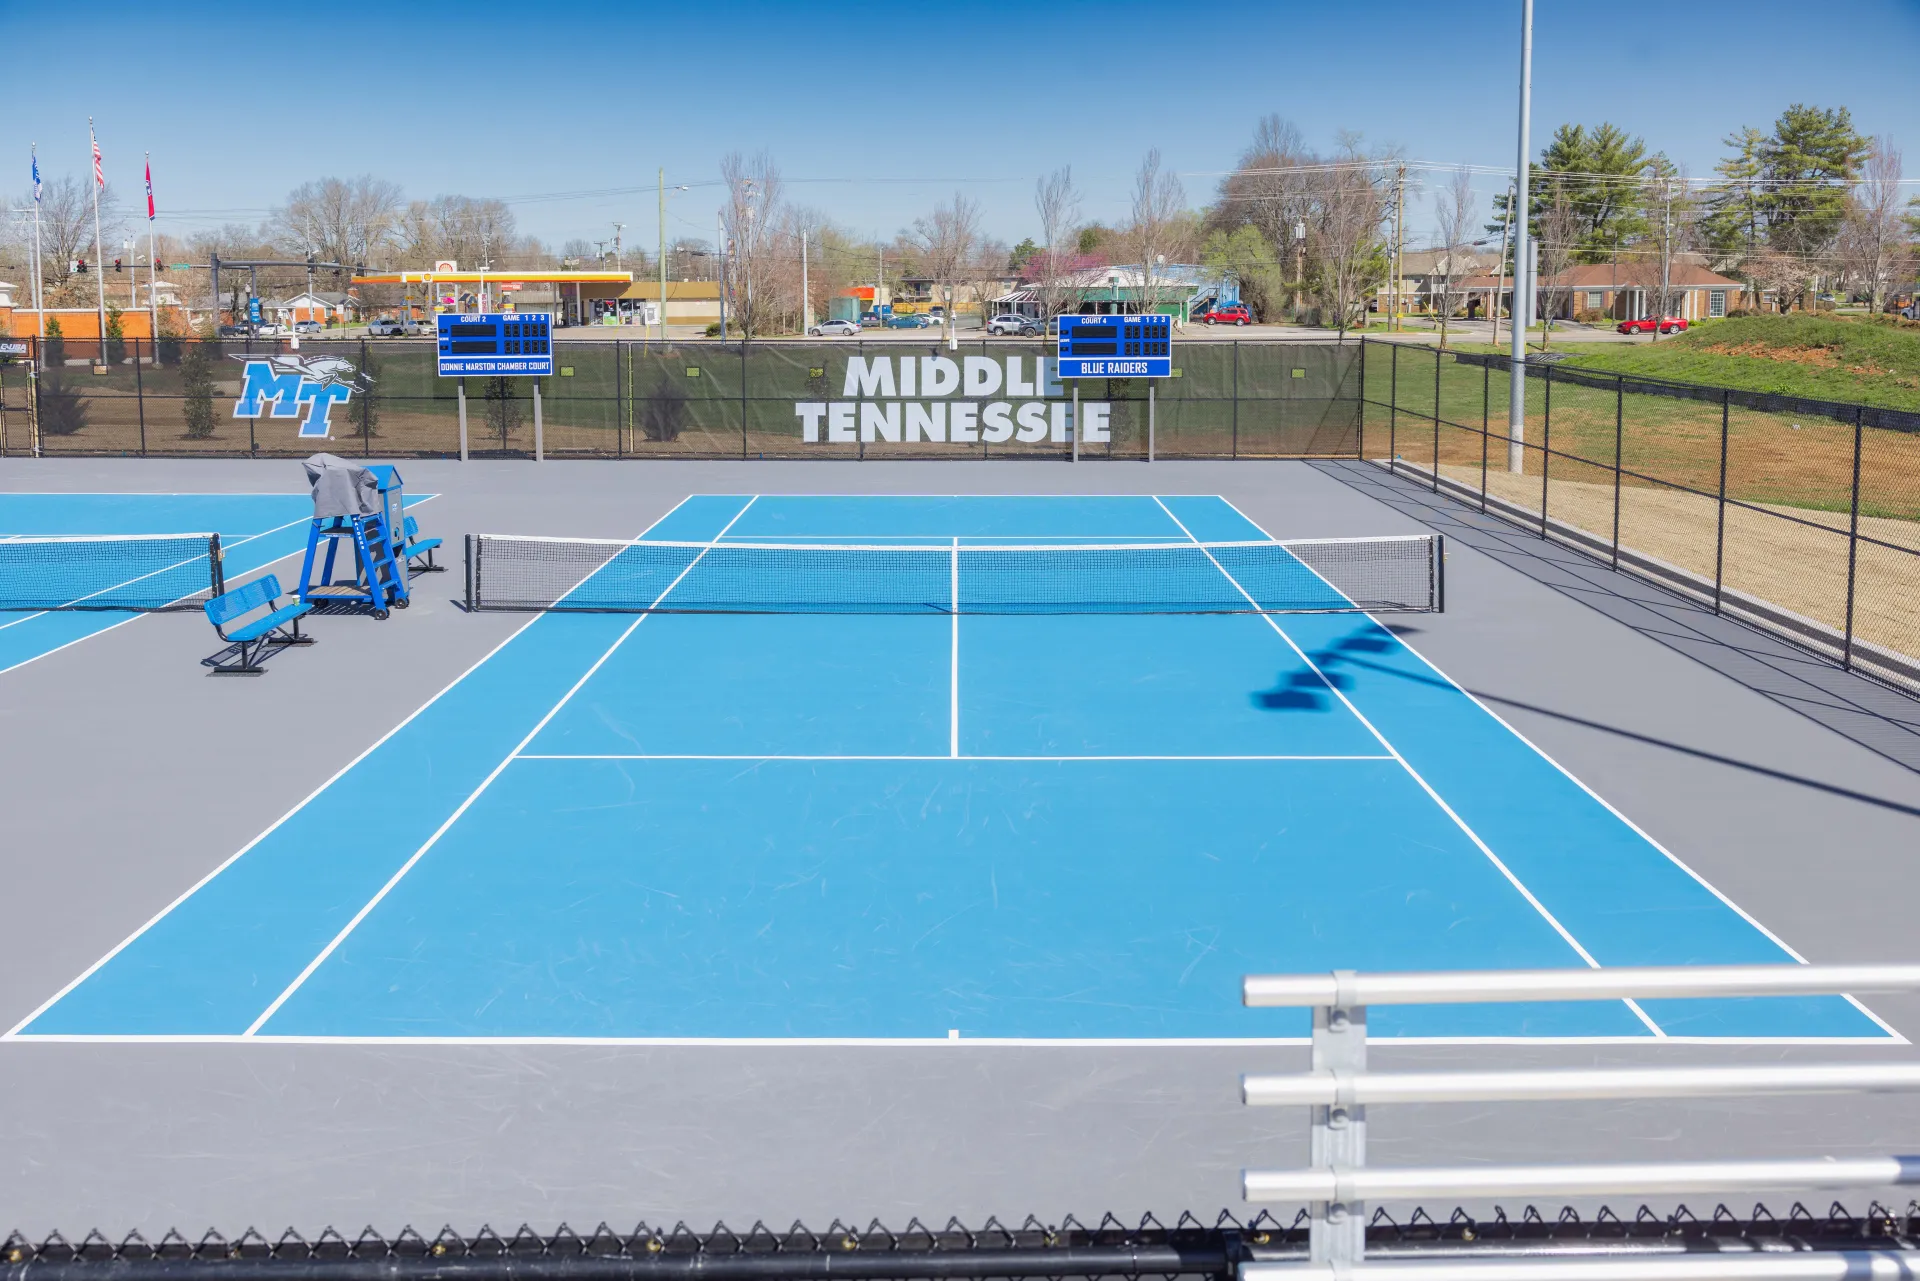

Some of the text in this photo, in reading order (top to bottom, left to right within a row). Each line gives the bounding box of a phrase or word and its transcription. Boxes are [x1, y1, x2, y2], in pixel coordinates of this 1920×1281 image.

[466, 362, 496, 370] MARSTON
[497, 362, 527, 370] CHAMBER
[528, 362, 549, 370] COURT
[1082, 362, 1148, 374] BLUE RAIDERS
[233, 361, 352, 438] MT
[795, 402, 1110, 442] TENNESSEE
